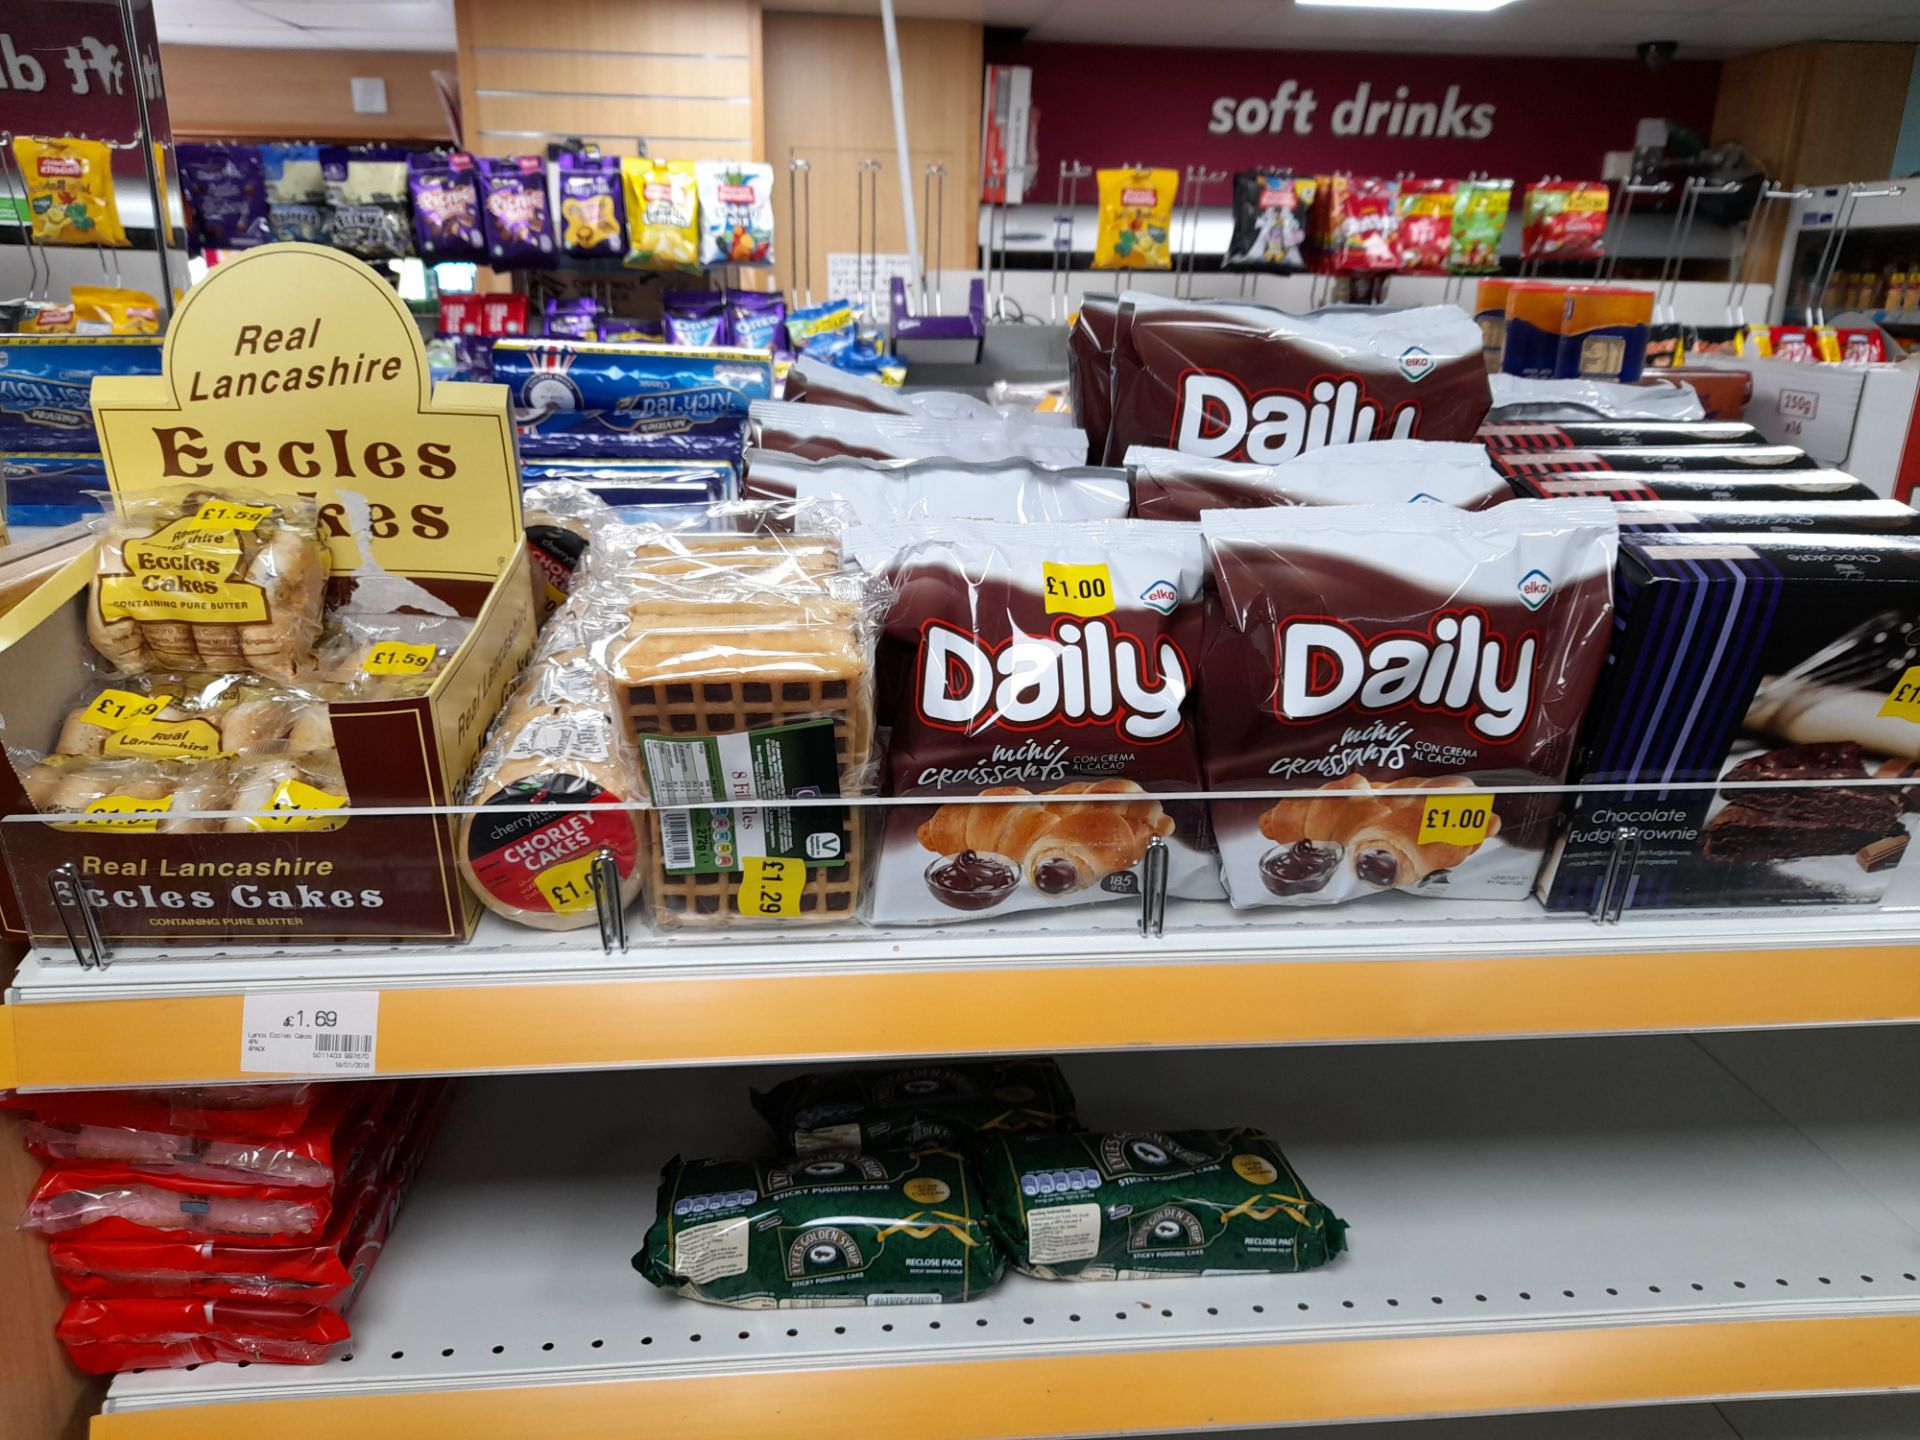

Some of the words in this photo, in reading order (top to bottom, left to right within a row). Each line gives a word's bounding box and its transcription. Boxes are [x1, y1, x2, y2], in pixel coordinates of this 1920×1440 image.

[1207, 80, 1318, 135] soft
[1331, 82, 1496, 139] drinks
[233, 318, 322, 357] Real
[190, 353, 401, 402] Lancashire
[151, 426, 457, 480] Eccles
[200, 508, 263, 523] £1.59
[137, 552, 221, 575] Eccles
[141, 574, 219, 595] Cakes
[1045, 576, 1106, 600] £1.00
[1149, 587, 1175, 601] elka
[1524, 581, 1548, 595] elka
[112, 599, 177, 609] CONTAINING
[180, 600, 207, 610] PURE
[210, 600, 249, 611] BUTTER
[372, 651, 429, 667] £1.59
[922, 620, 1187, 738] Daily
[1282, 614, 1536, 737] Daily
[457, 683, 482, 746] Real
[1073, 755, 1098, 765] CON
[1100, 753, 1136, 763] CREMA
[1411, 750, 1427, 761] AL
[1429, 752, 1466, 766] CACAO
[1414, 741, 1440, 753] CON
[1443, 746, 1478, 759] CREMA
[1072, 763, 1085, 771] AL
[1086, 761, 1125, 771] CACAO
[1425, 808, 1486, 829] £1.00
[1591, 809, 1687, 824] Chocolate
[503, 812, 595, 864] CHORLEY
[696, 828, 707, 851] 272g
[524, 830, 592, 871] CAKES
[82, 856, 147, 876] Real
[159, 857, 334, 877] Lancashire
[758, 860, 786, 914] £1.29
[1108, 875, 1132, 887] 185
[51, 880, 215, 910] Eccles
[230, 884, 384, 910] Cakes
[149, 917, 220, 927] CONTAINING
[222, 917, 255, 926] PURE
[256, 917, 304, 926] BUTTER
[283, 1009, 338, 1028] £1.69
[800, 1229, 839, 1247] GOLDEN
[905, 1258, 940, 1267] RECLOSE
[941, 1258, 963, 1267] PACK
